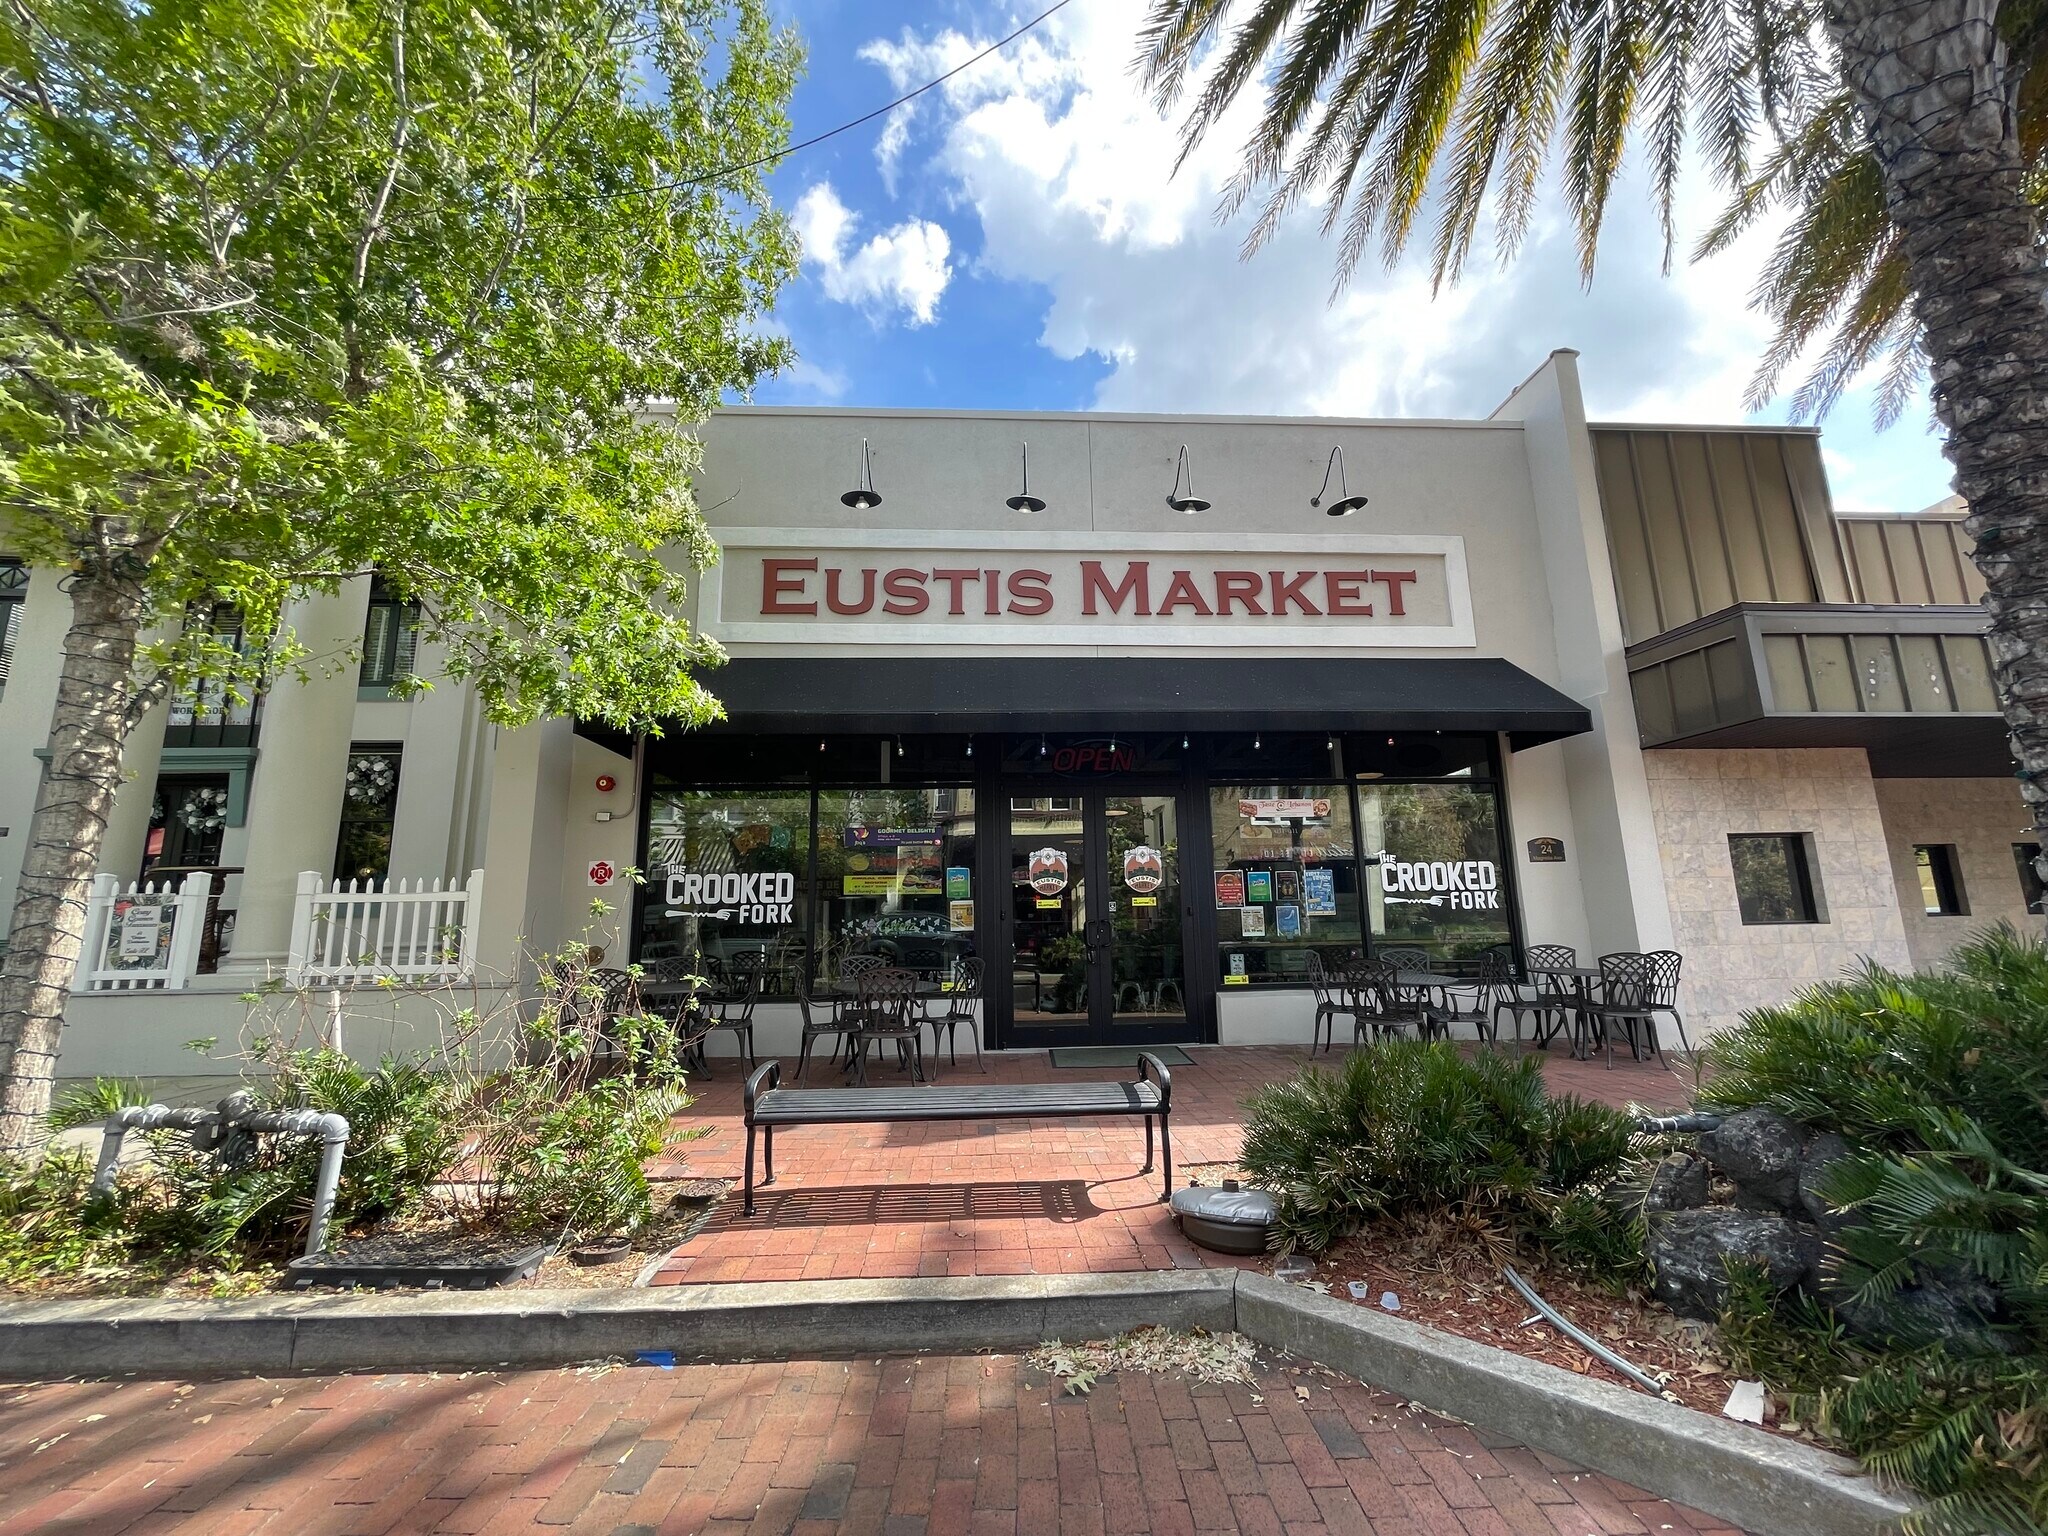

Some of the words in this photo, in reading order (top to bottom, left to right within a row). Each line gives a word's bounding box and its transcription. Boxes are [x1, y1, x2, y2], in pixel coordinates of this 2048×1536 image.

[759, 556, 1054, 616] EUSTIS
[1080, 560, 1417, 616] MARKET
[1053, 746, 1135, 772] OPEN
[1374, 850, 1396, 864] THE
[1540, 845, 1553, 854] 24
[597, 870, 605, 878] R
[661, 861, 687, 875] THE
[1380, 861, 1497, 892] CROOKED
[665, 872, 794, 905] CROOKED
[1450, 890, 1499, 910] FORK
[739, 904, 793, 924] FORK
